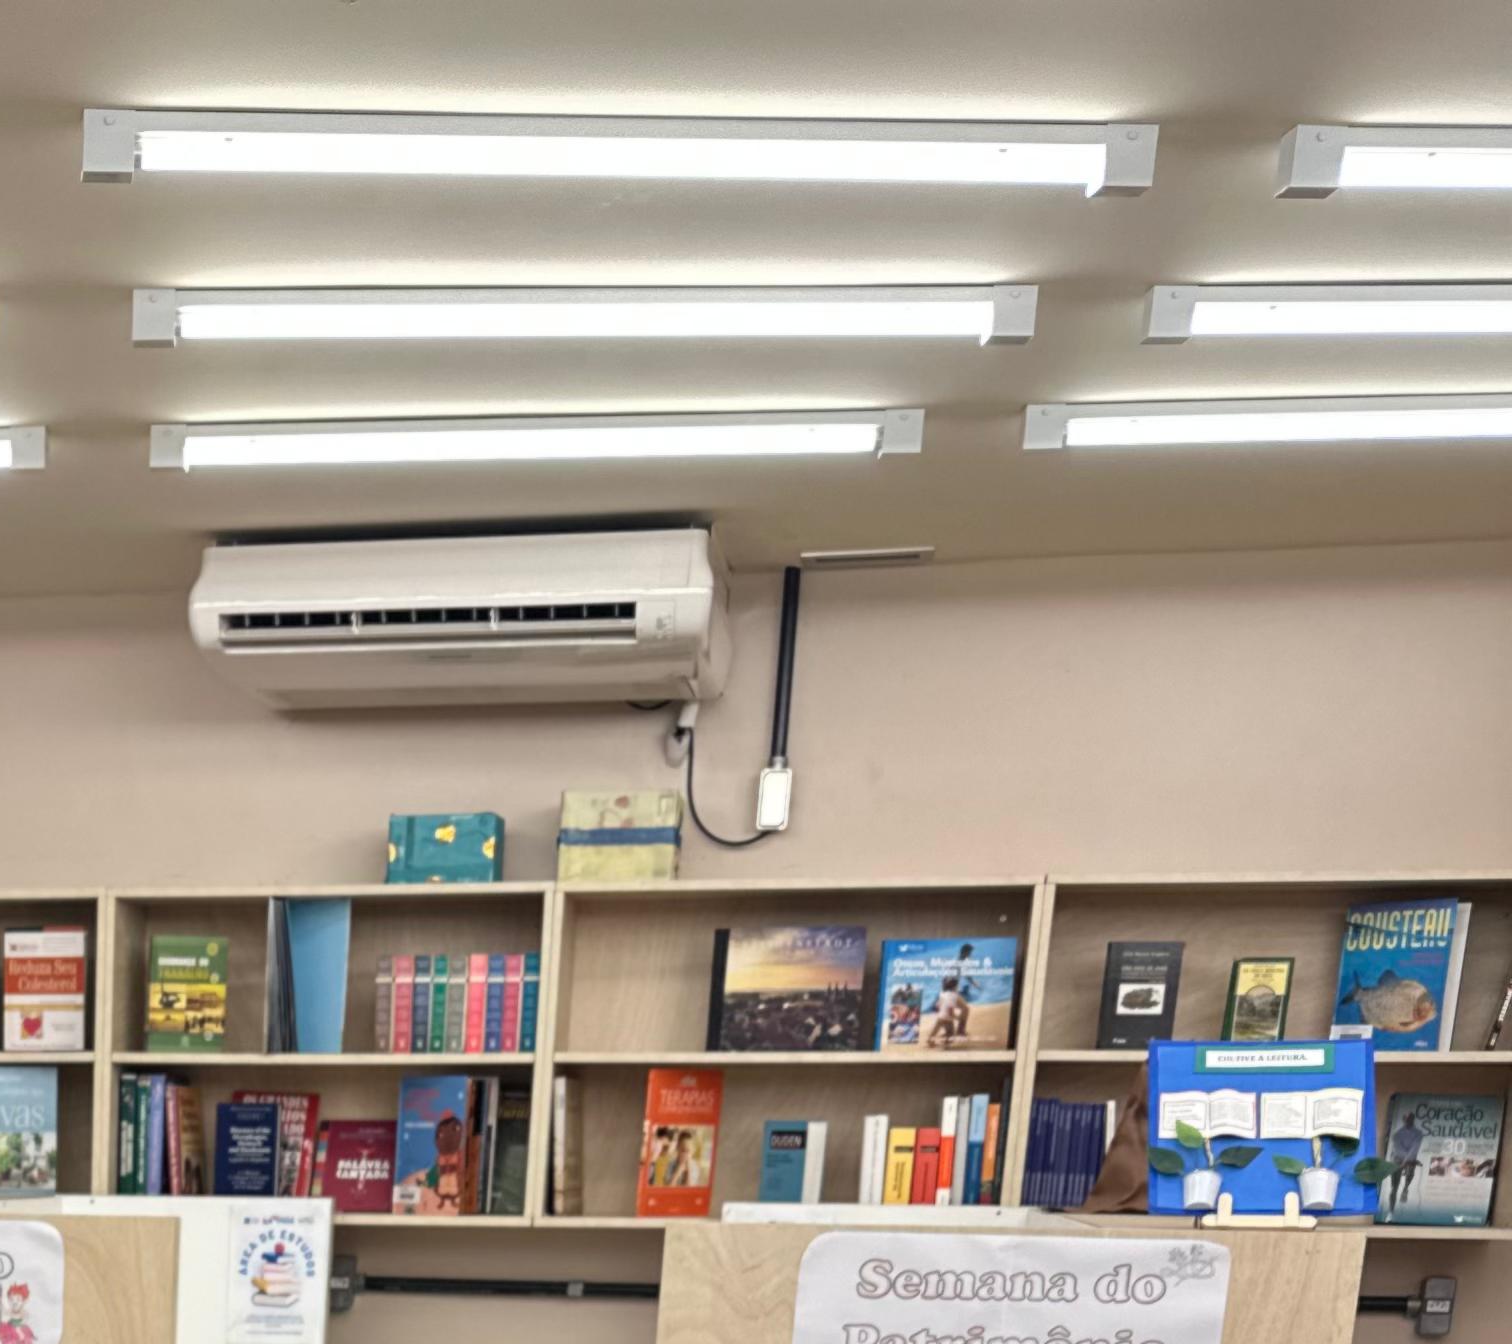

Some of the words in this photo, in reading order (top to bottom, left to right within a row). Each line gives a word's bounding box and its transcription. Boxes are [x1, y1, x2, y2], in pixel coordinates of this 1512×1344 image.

[1346, 908, 1452, 951] COUSTEAU
[55, 960, 77, 975] Seu
[18, 976, 77, 991] Colesterol
[1415, 1103, 1484, 1124] Coração
[1421, 1120, 1498, 1140] Saudável
[770, 1134, 803, 1149] DUDEN
[1443, 1139, 1466, 1154] 30
[856, 1257, 1079, 1303] Semana
[1093, 1263, 1168, 1305] do
